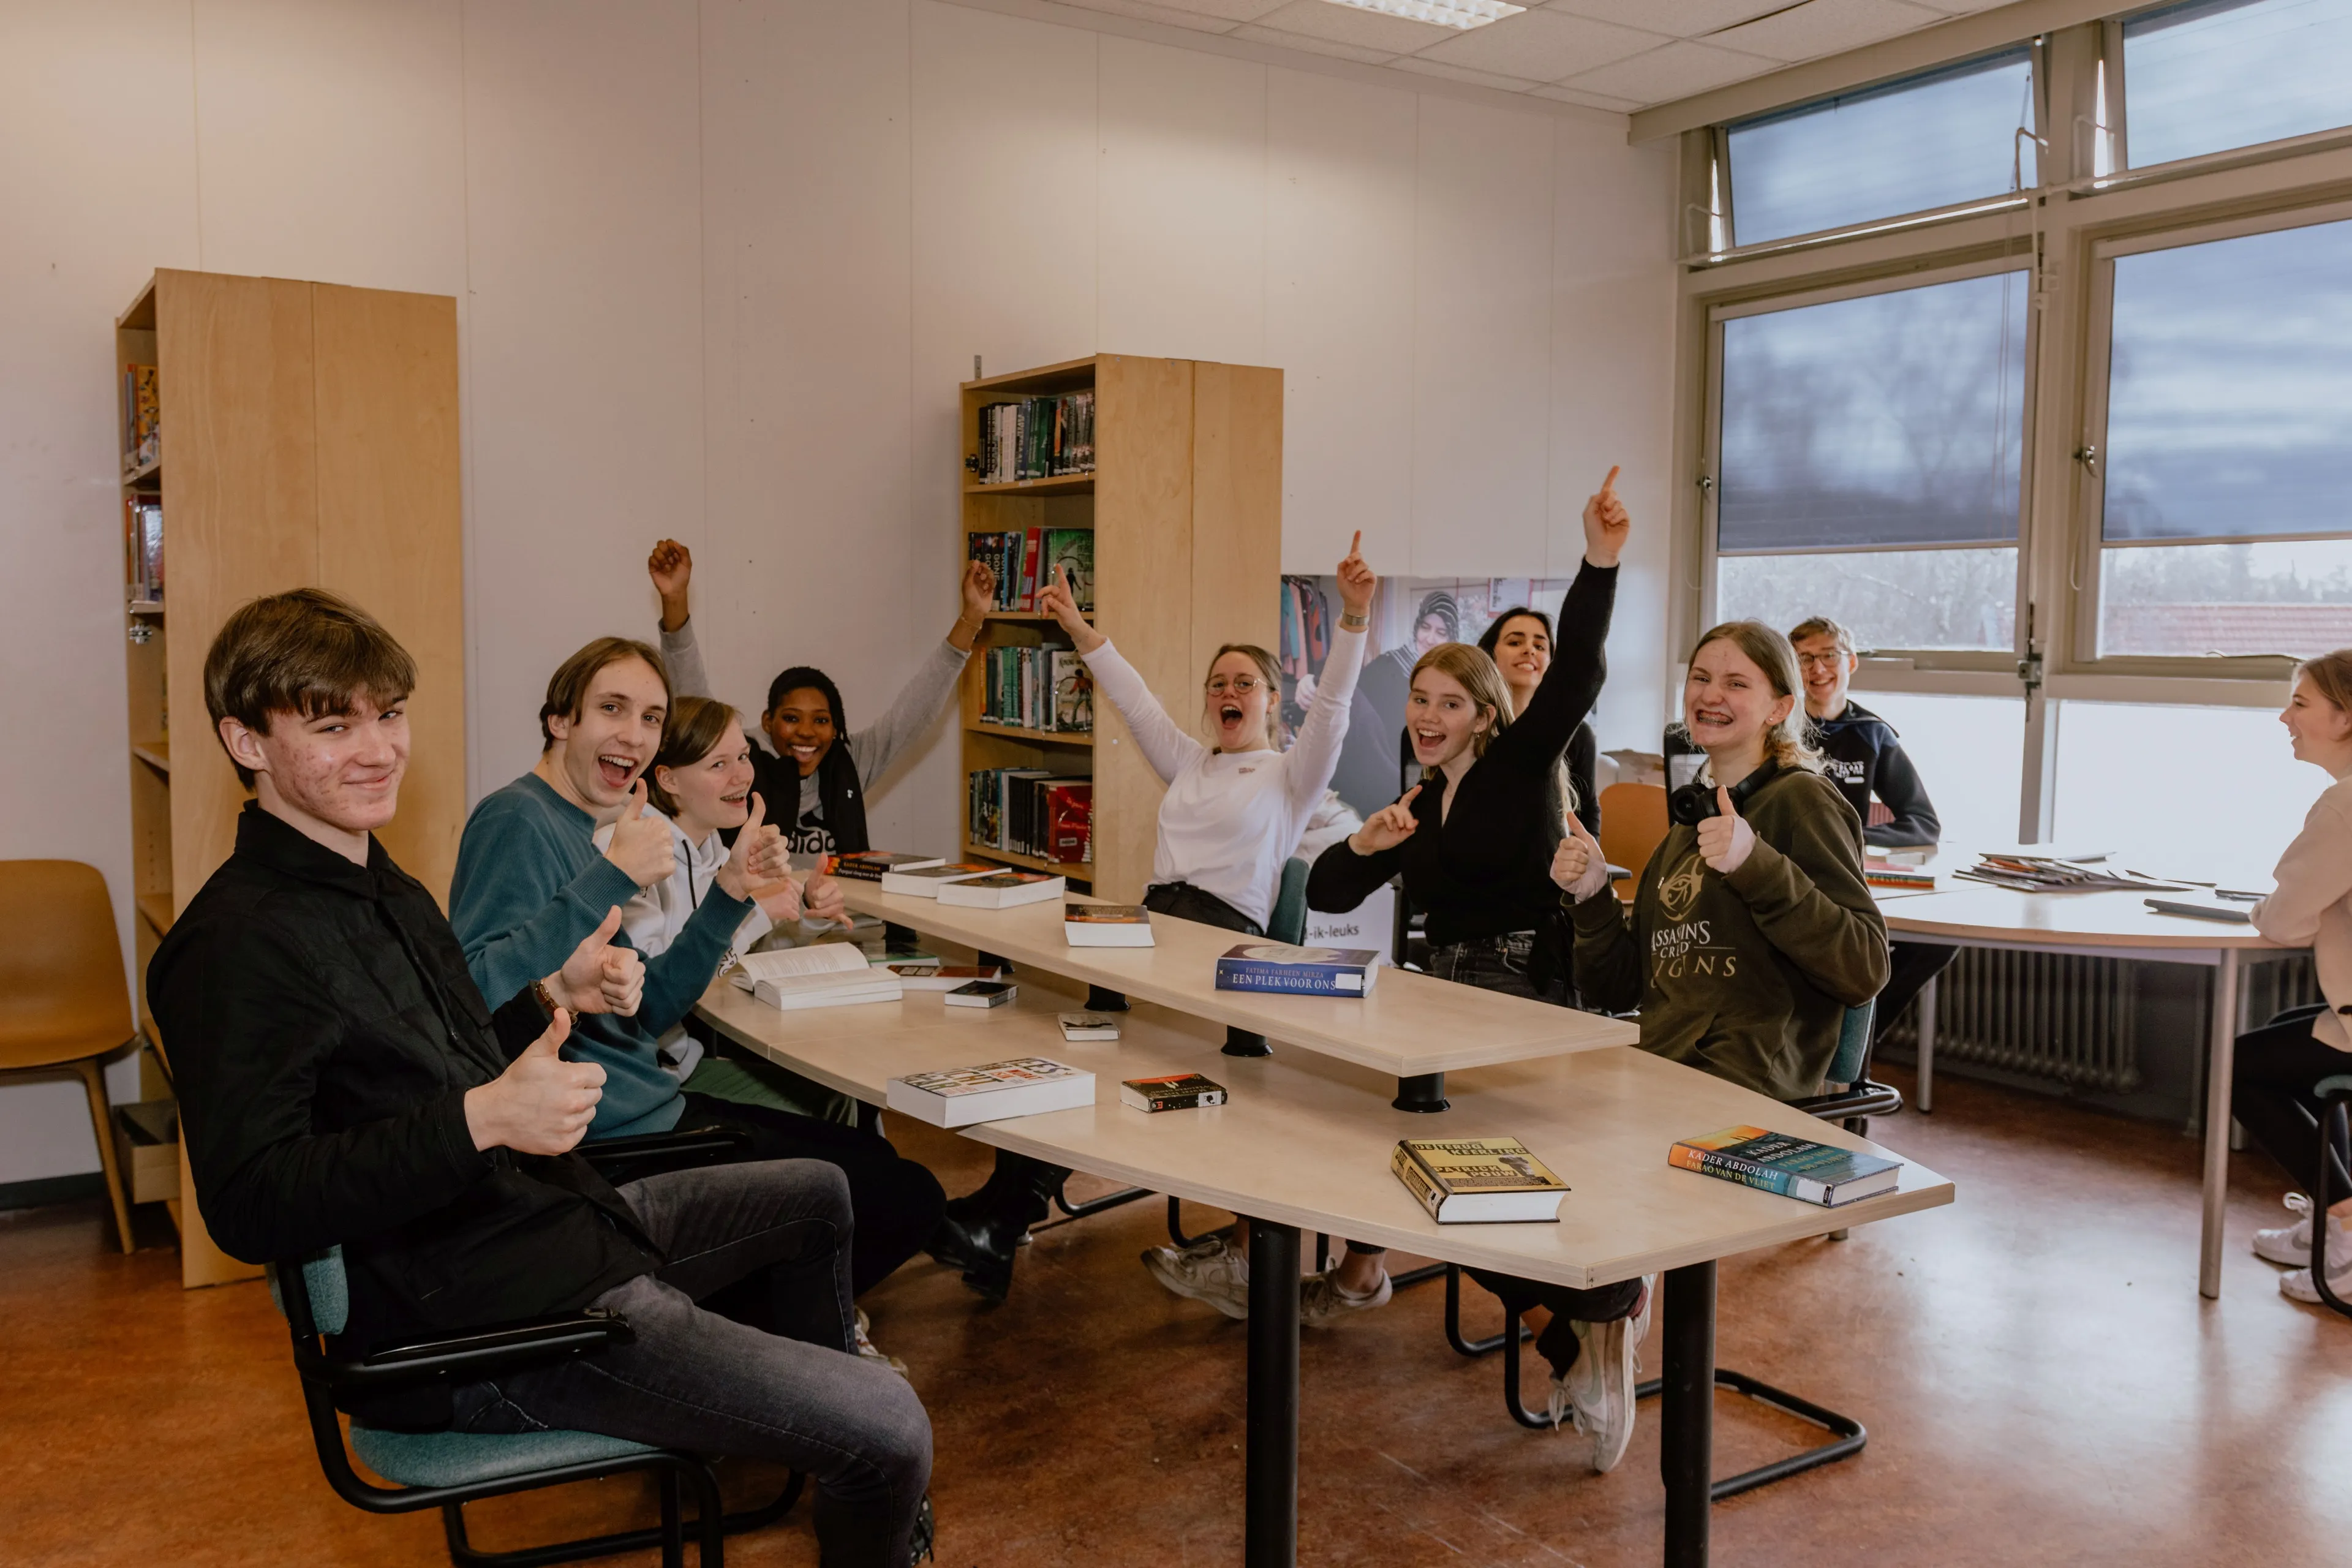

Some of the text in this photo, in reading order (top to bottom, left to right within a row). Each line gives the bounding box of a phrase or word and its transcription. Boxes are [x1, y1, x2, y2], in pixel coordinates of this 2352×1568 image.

[786, 831, 837, 854] dida
[1271, 968, 1300, 977] FARHEEN
[1651, 955, 1736, 988] IGINS
[1232, 974, 1336, 991] EEN PLEK VOOR ONS
[1746, 1141, 1791, 1156] KADER
[1757, 1143, 1818, 1163] ABDOLAH
[1687, 1150, 1778, 1181] KADER ABDOLAH
[1778, 1154, 1814, 1167] FARAO
[1686, 1159, 1775, 1190] FARAO VAN DE VLIET
